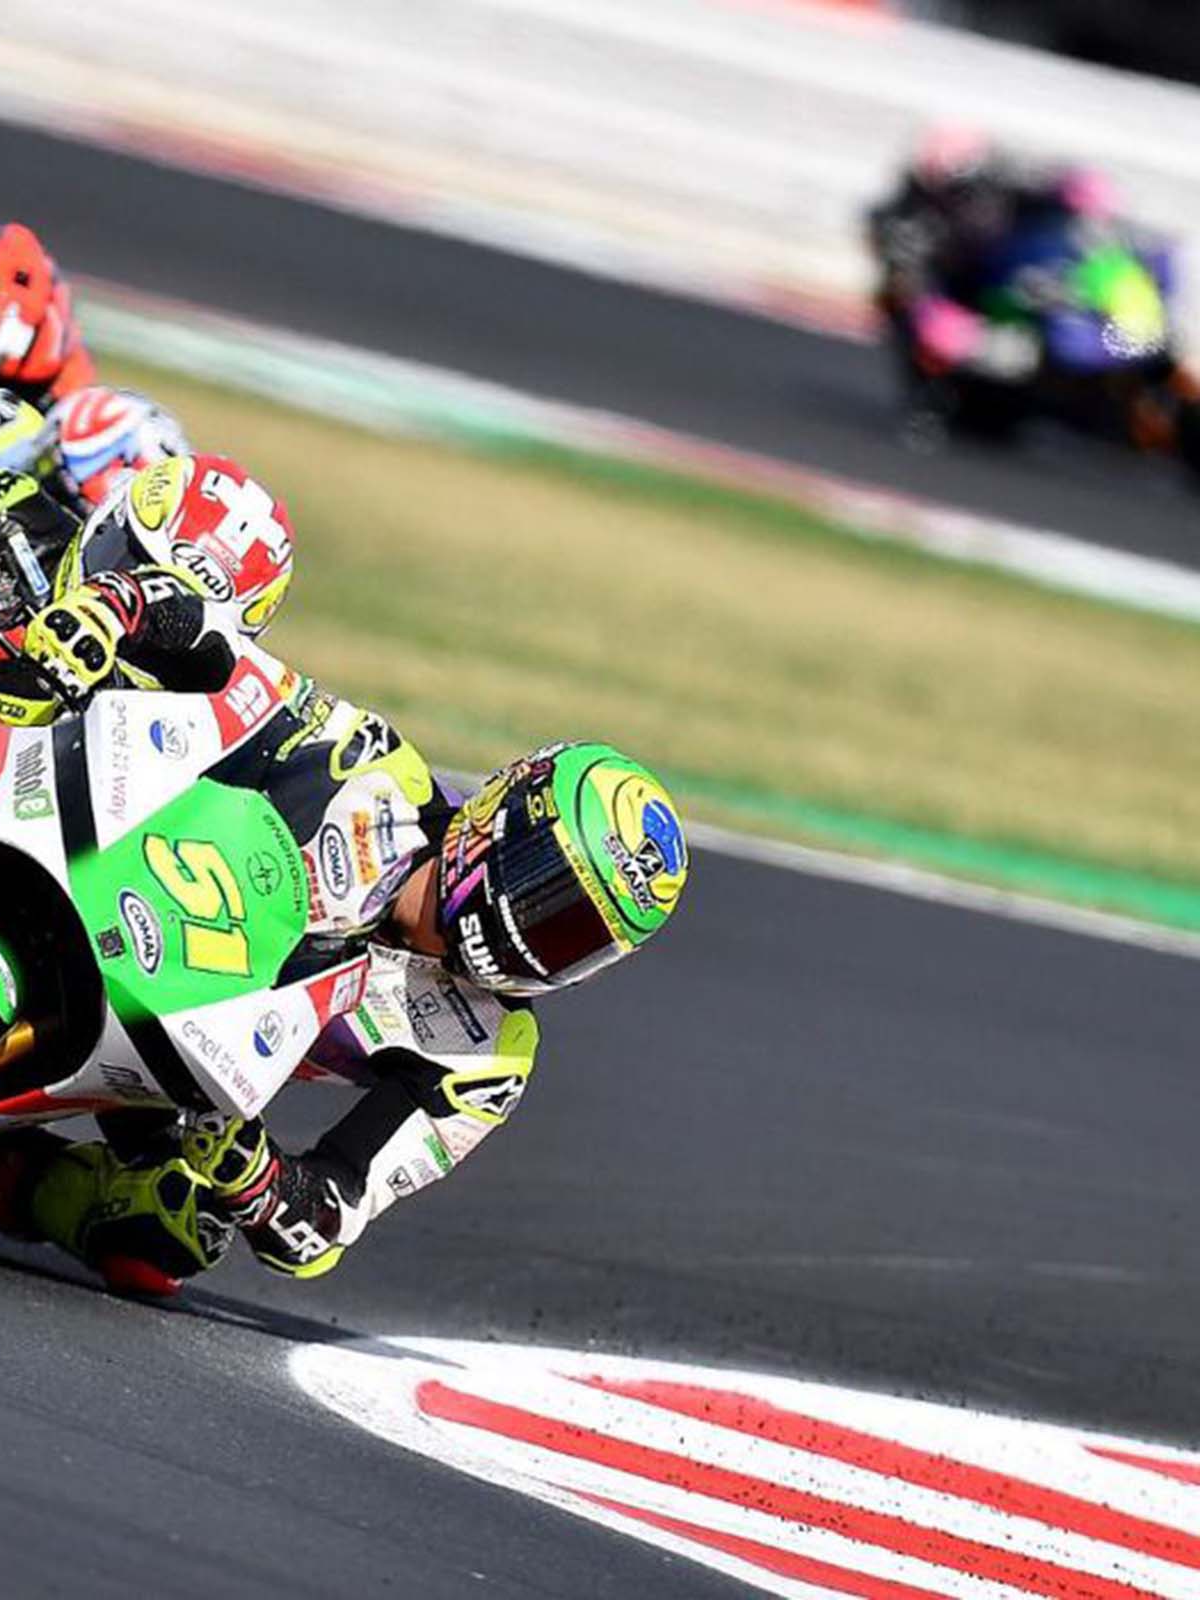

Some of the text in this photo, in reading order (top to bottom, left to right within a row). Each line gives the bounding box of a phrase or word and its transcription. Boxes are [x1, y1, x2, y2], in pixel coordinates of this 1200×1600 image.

[184, 548, 232, 600] Arai
[323, 836, 347, 889] COMAL
[127, 904, 157, 960] COMAL
[143, 833, 253, 978] 51
